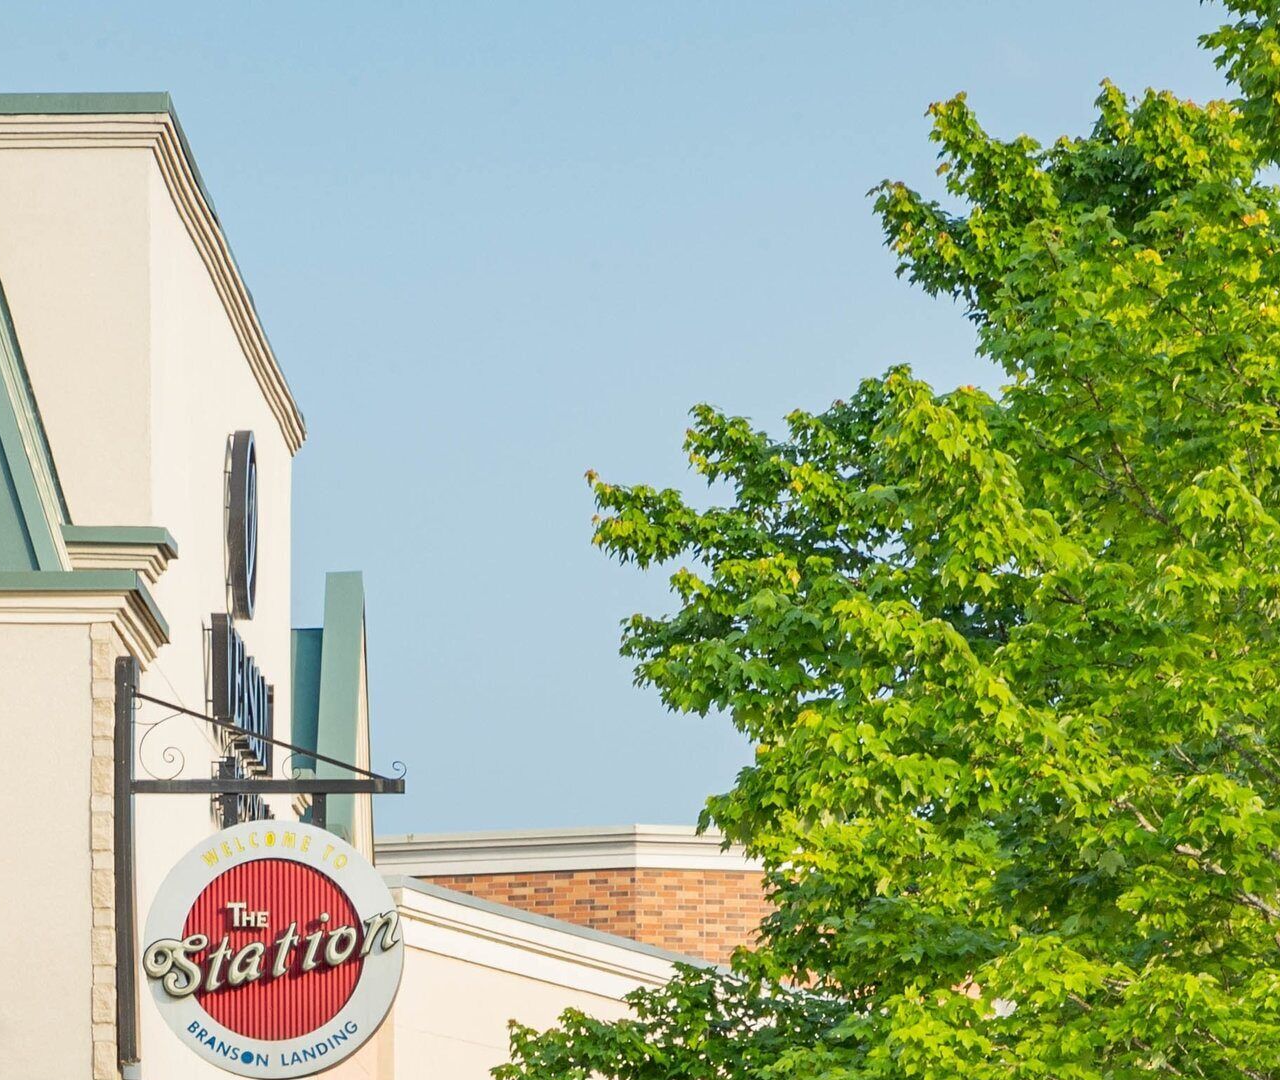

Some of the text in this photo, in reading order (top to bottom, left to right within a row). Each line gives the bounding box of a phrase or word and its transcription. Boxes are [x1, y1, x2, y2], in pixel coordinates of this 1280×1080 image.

[200, 830, 349, 870] WELCOME TO
[227, 902, 270, 929] THE
[143, 909, 401, 999] Station
[186, 1020, 359, 1067] BRANSON LANDING
